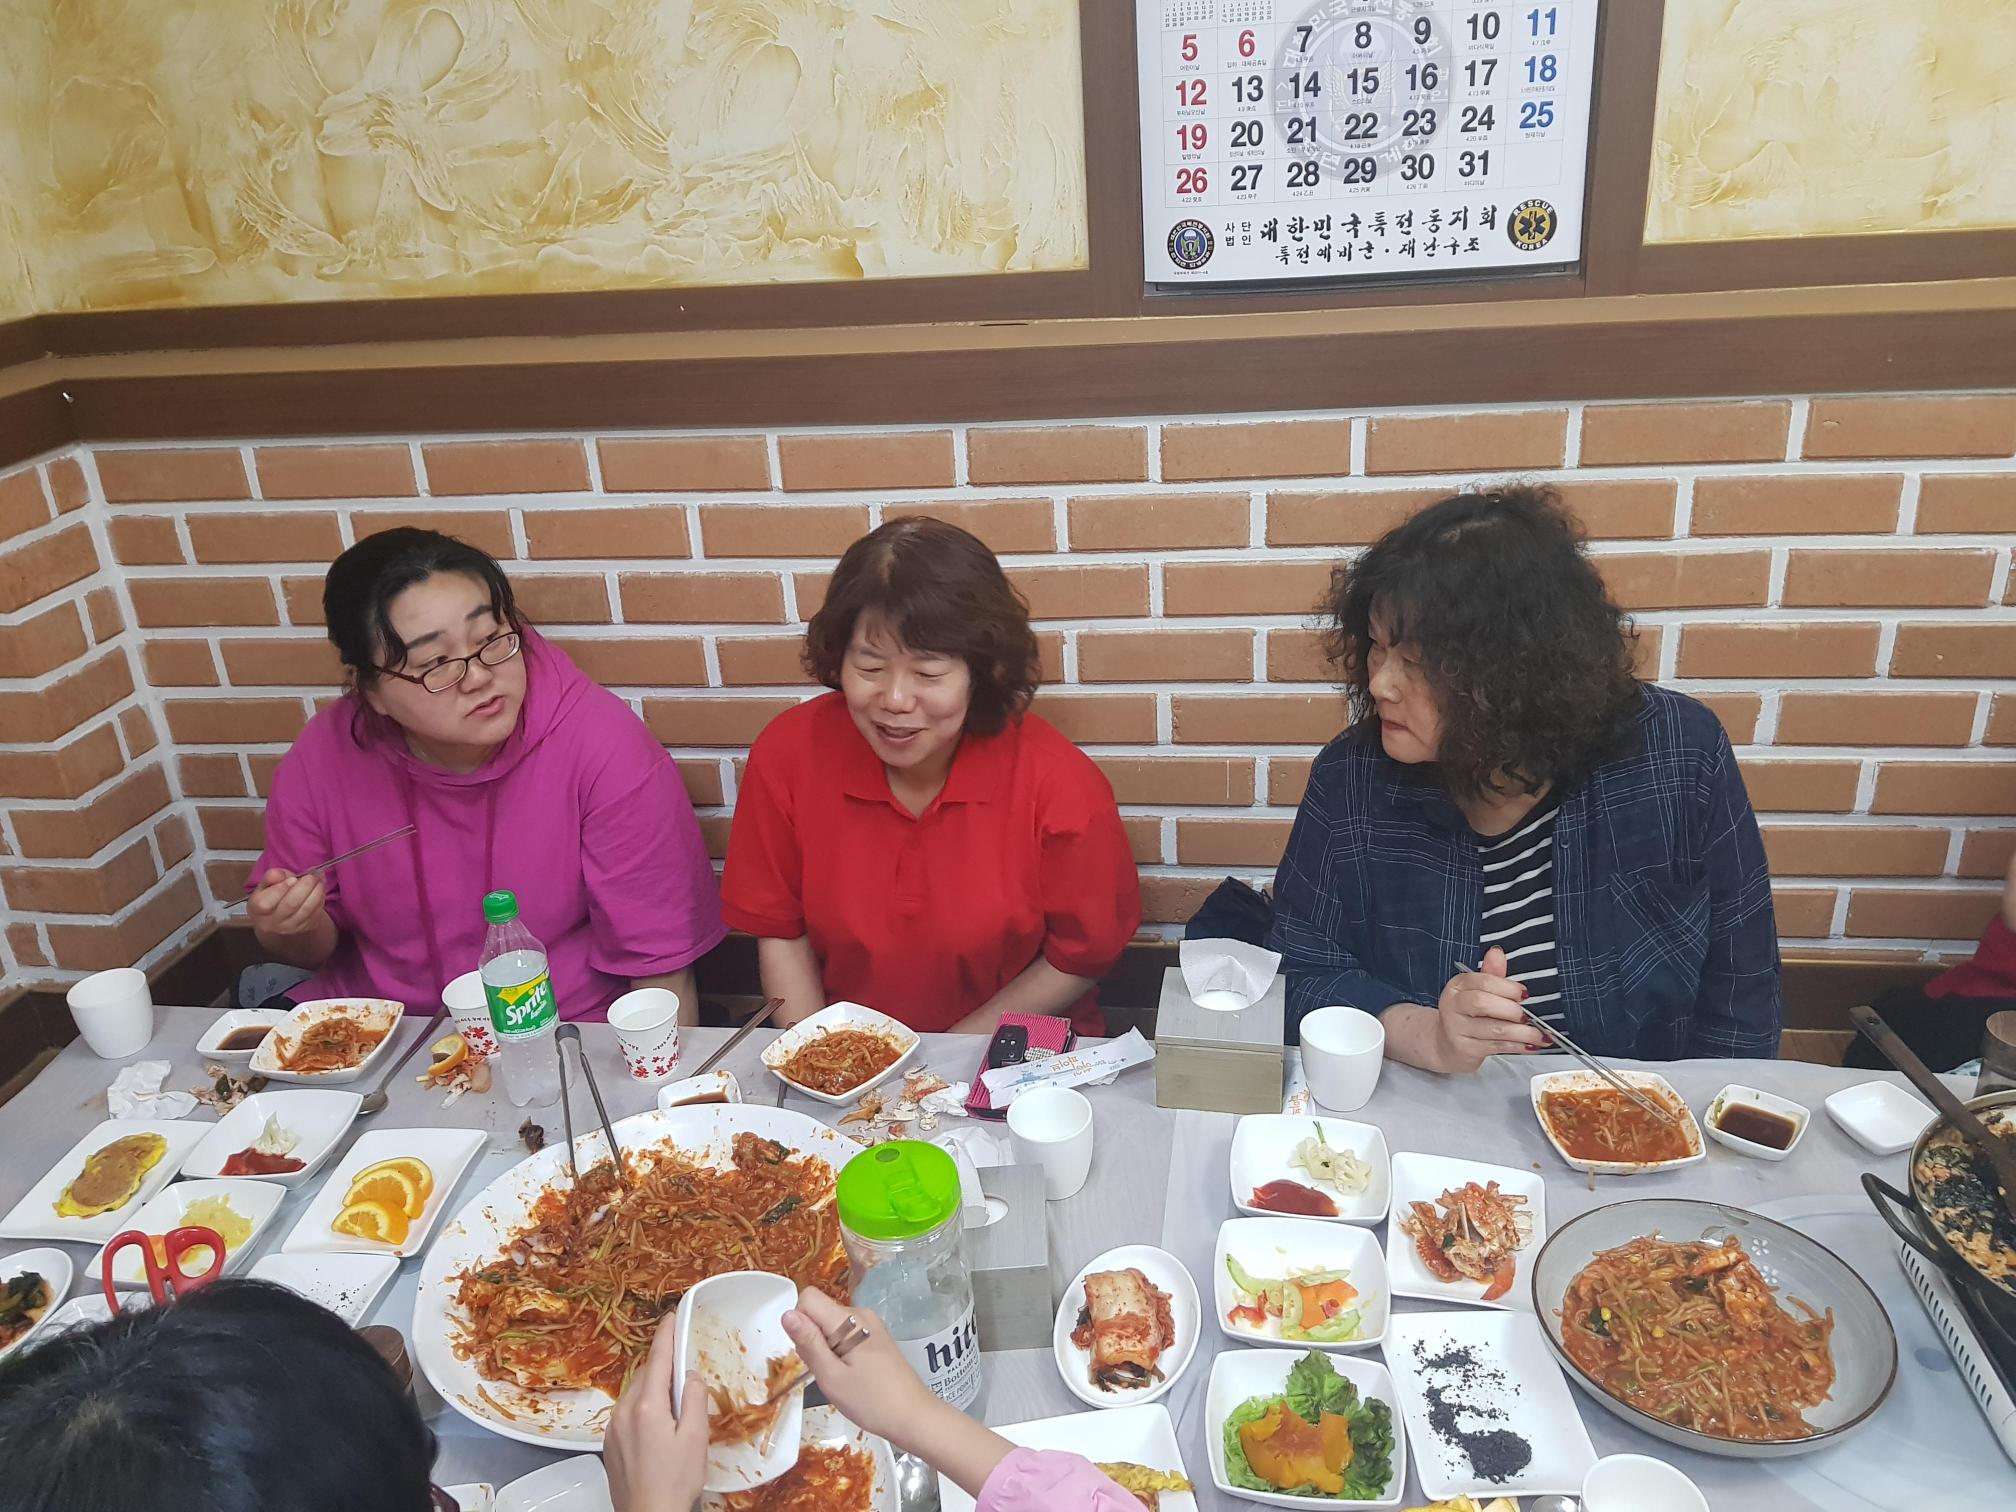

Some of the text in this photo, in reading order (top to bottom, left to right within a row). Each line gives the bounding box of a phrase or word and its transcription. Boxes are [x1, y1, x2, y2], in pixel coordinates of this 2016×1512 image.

[1182, 7, 1557, 61] 5 6 7 8 9 10 11
[1176, 54, 1557, 106] 12 13 14 15 16 17 18
[1176, 100, 1554, 151] 19 20 21 22 23 24 25
[1176, 150, 1489, 194] 26 27 28 29 30 31
[1225, 221, 1251, 233] 사단
[1513, 200, 1553, 216] RESCUE
[1225, 235, 1251, 246] 법인
[1516, 239, 1548, 250] KOREA
[505, 981, 547, 1026] Sprite
